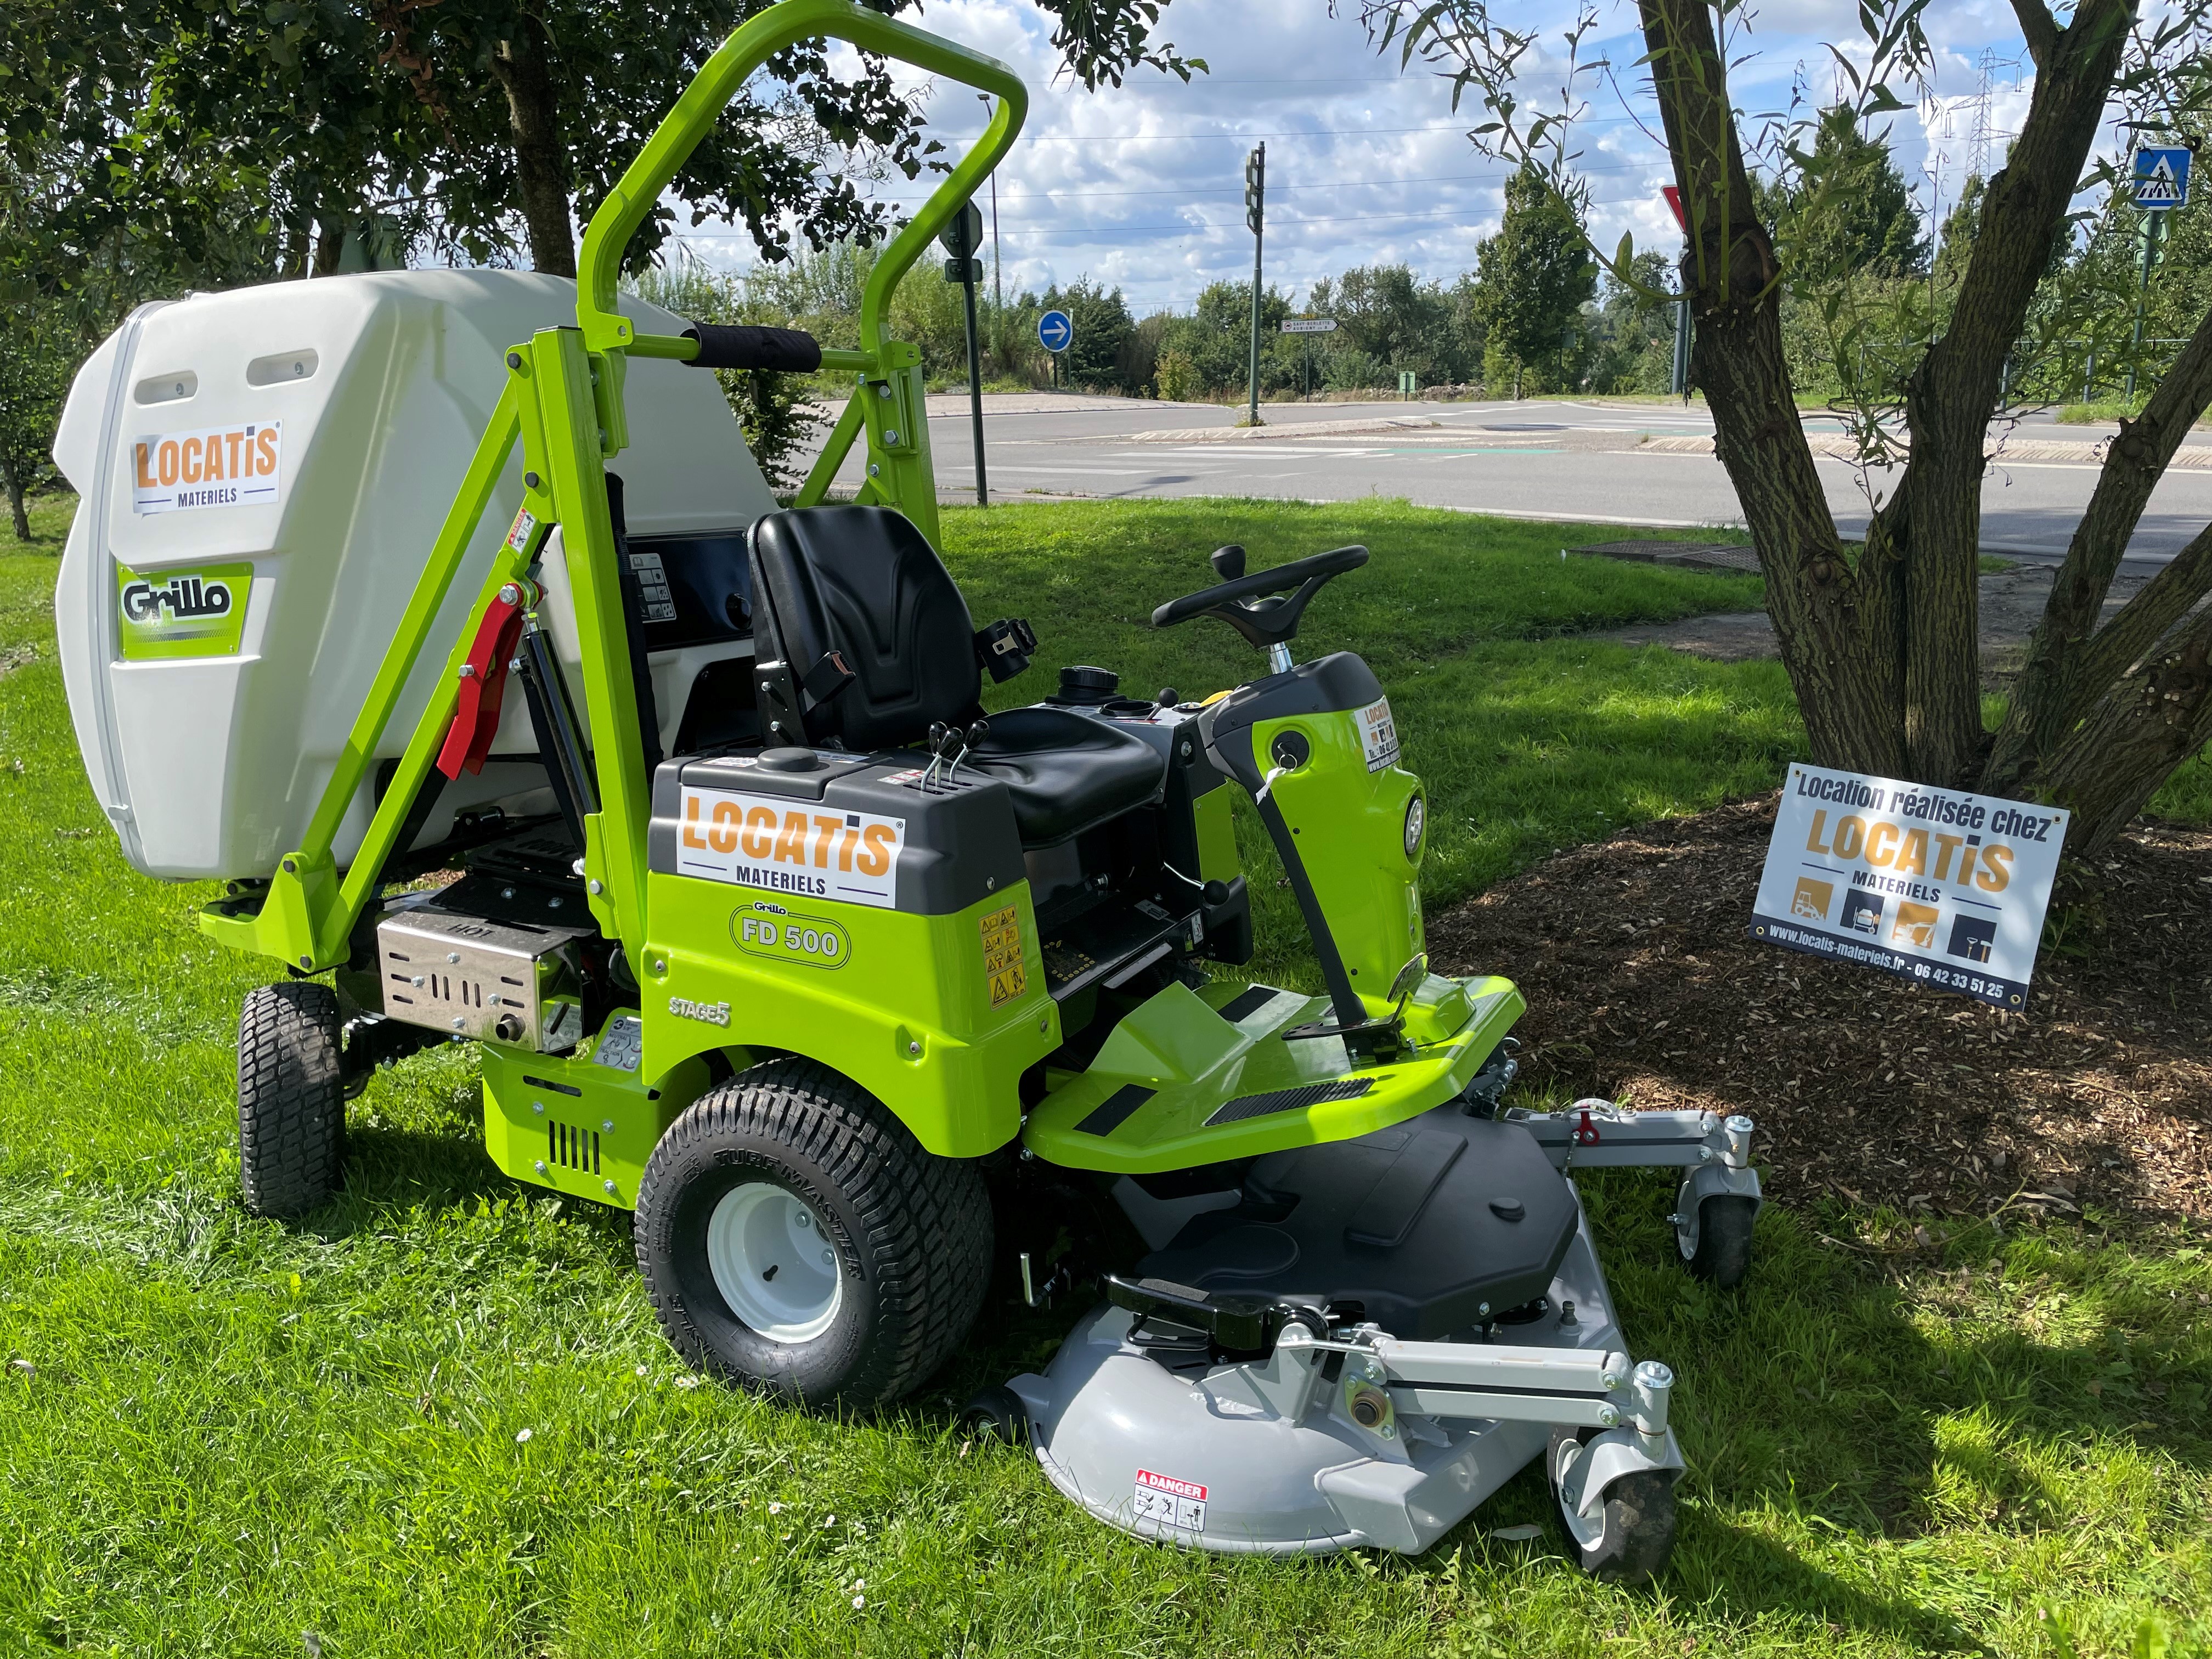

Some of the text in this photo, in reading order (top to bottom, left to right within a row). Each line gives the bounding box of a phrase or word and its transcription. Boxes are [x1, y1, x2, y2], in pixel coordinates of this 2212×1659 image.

[178, 488, 237, 508] MATERIELS
[512, 511, 526, 535] DANGER
[124, 578, 230, 621] Grillo
[1797, 773, 2052, 843] Location réalisée chez
[736, 865, 826, 895] MATERIELS
[1852, 870, 1942, 902] MATERIELS
[754, 902, 786, 915] Grillo
[447, 924, 495, 938] HOT
[742, 917, 839, 957] FD 500
[1769, 924, 1905, 972] www.locatis-materiels.fr
[1915, 963, 1930, 979] 06
[1933, 968, 1949, 984] 42
[1951, 972, 1968, 989] 33
[1970, 977, 1985, 995] 51
[1987, 982, 2004, 999] 25
[608, 1032, 628, 1041] NEUTRAL
[600, 1048, 620, 1057] TRACTION
[713, 1148, 782, 1170] TURF
[781, 1163, 865, 1282] MASTER
[1149, 1474, 1202, 1499] DANGER
